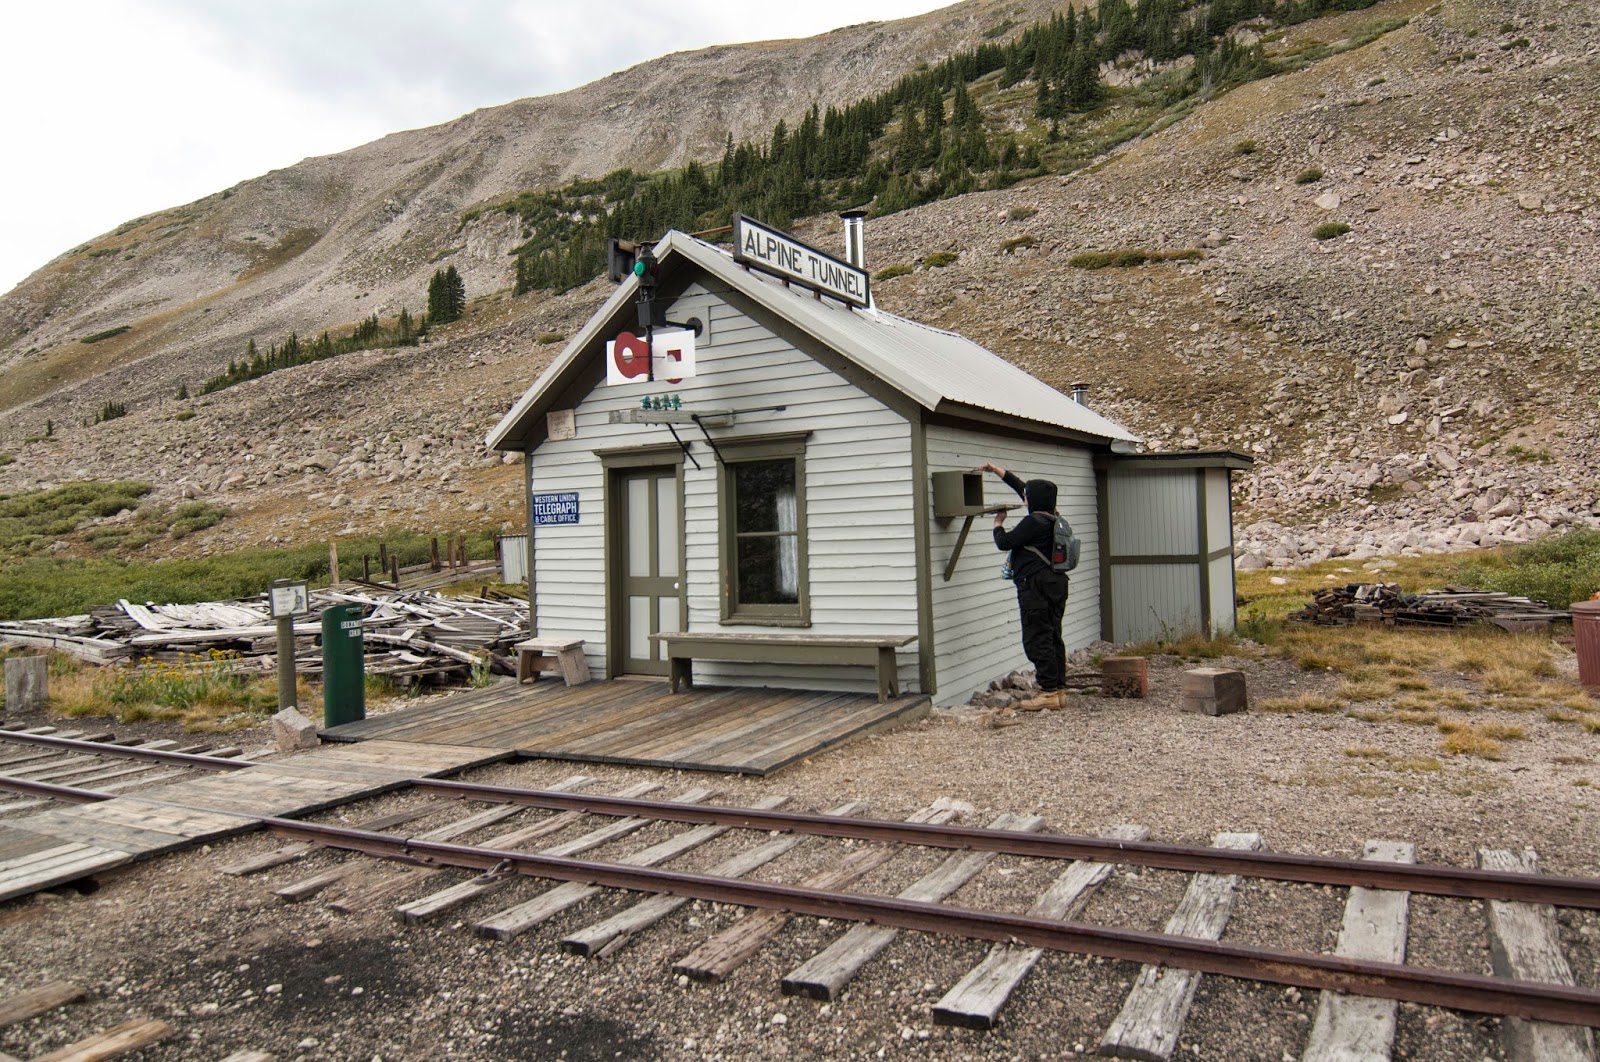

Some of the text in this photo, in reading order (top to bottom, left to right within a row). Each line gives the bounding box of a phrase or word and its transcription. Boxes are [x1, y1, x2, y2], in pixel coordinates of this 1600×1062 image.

[745, 229, 863, 298] ALPINE TUNNEL
[535, 494, 576, 503] WESTERN UNION
[534, 502, 577, 515] TELEGRAPH
[540, 515, 557, 523] CABLE
[558, 514, 577, 522] OFFICE
